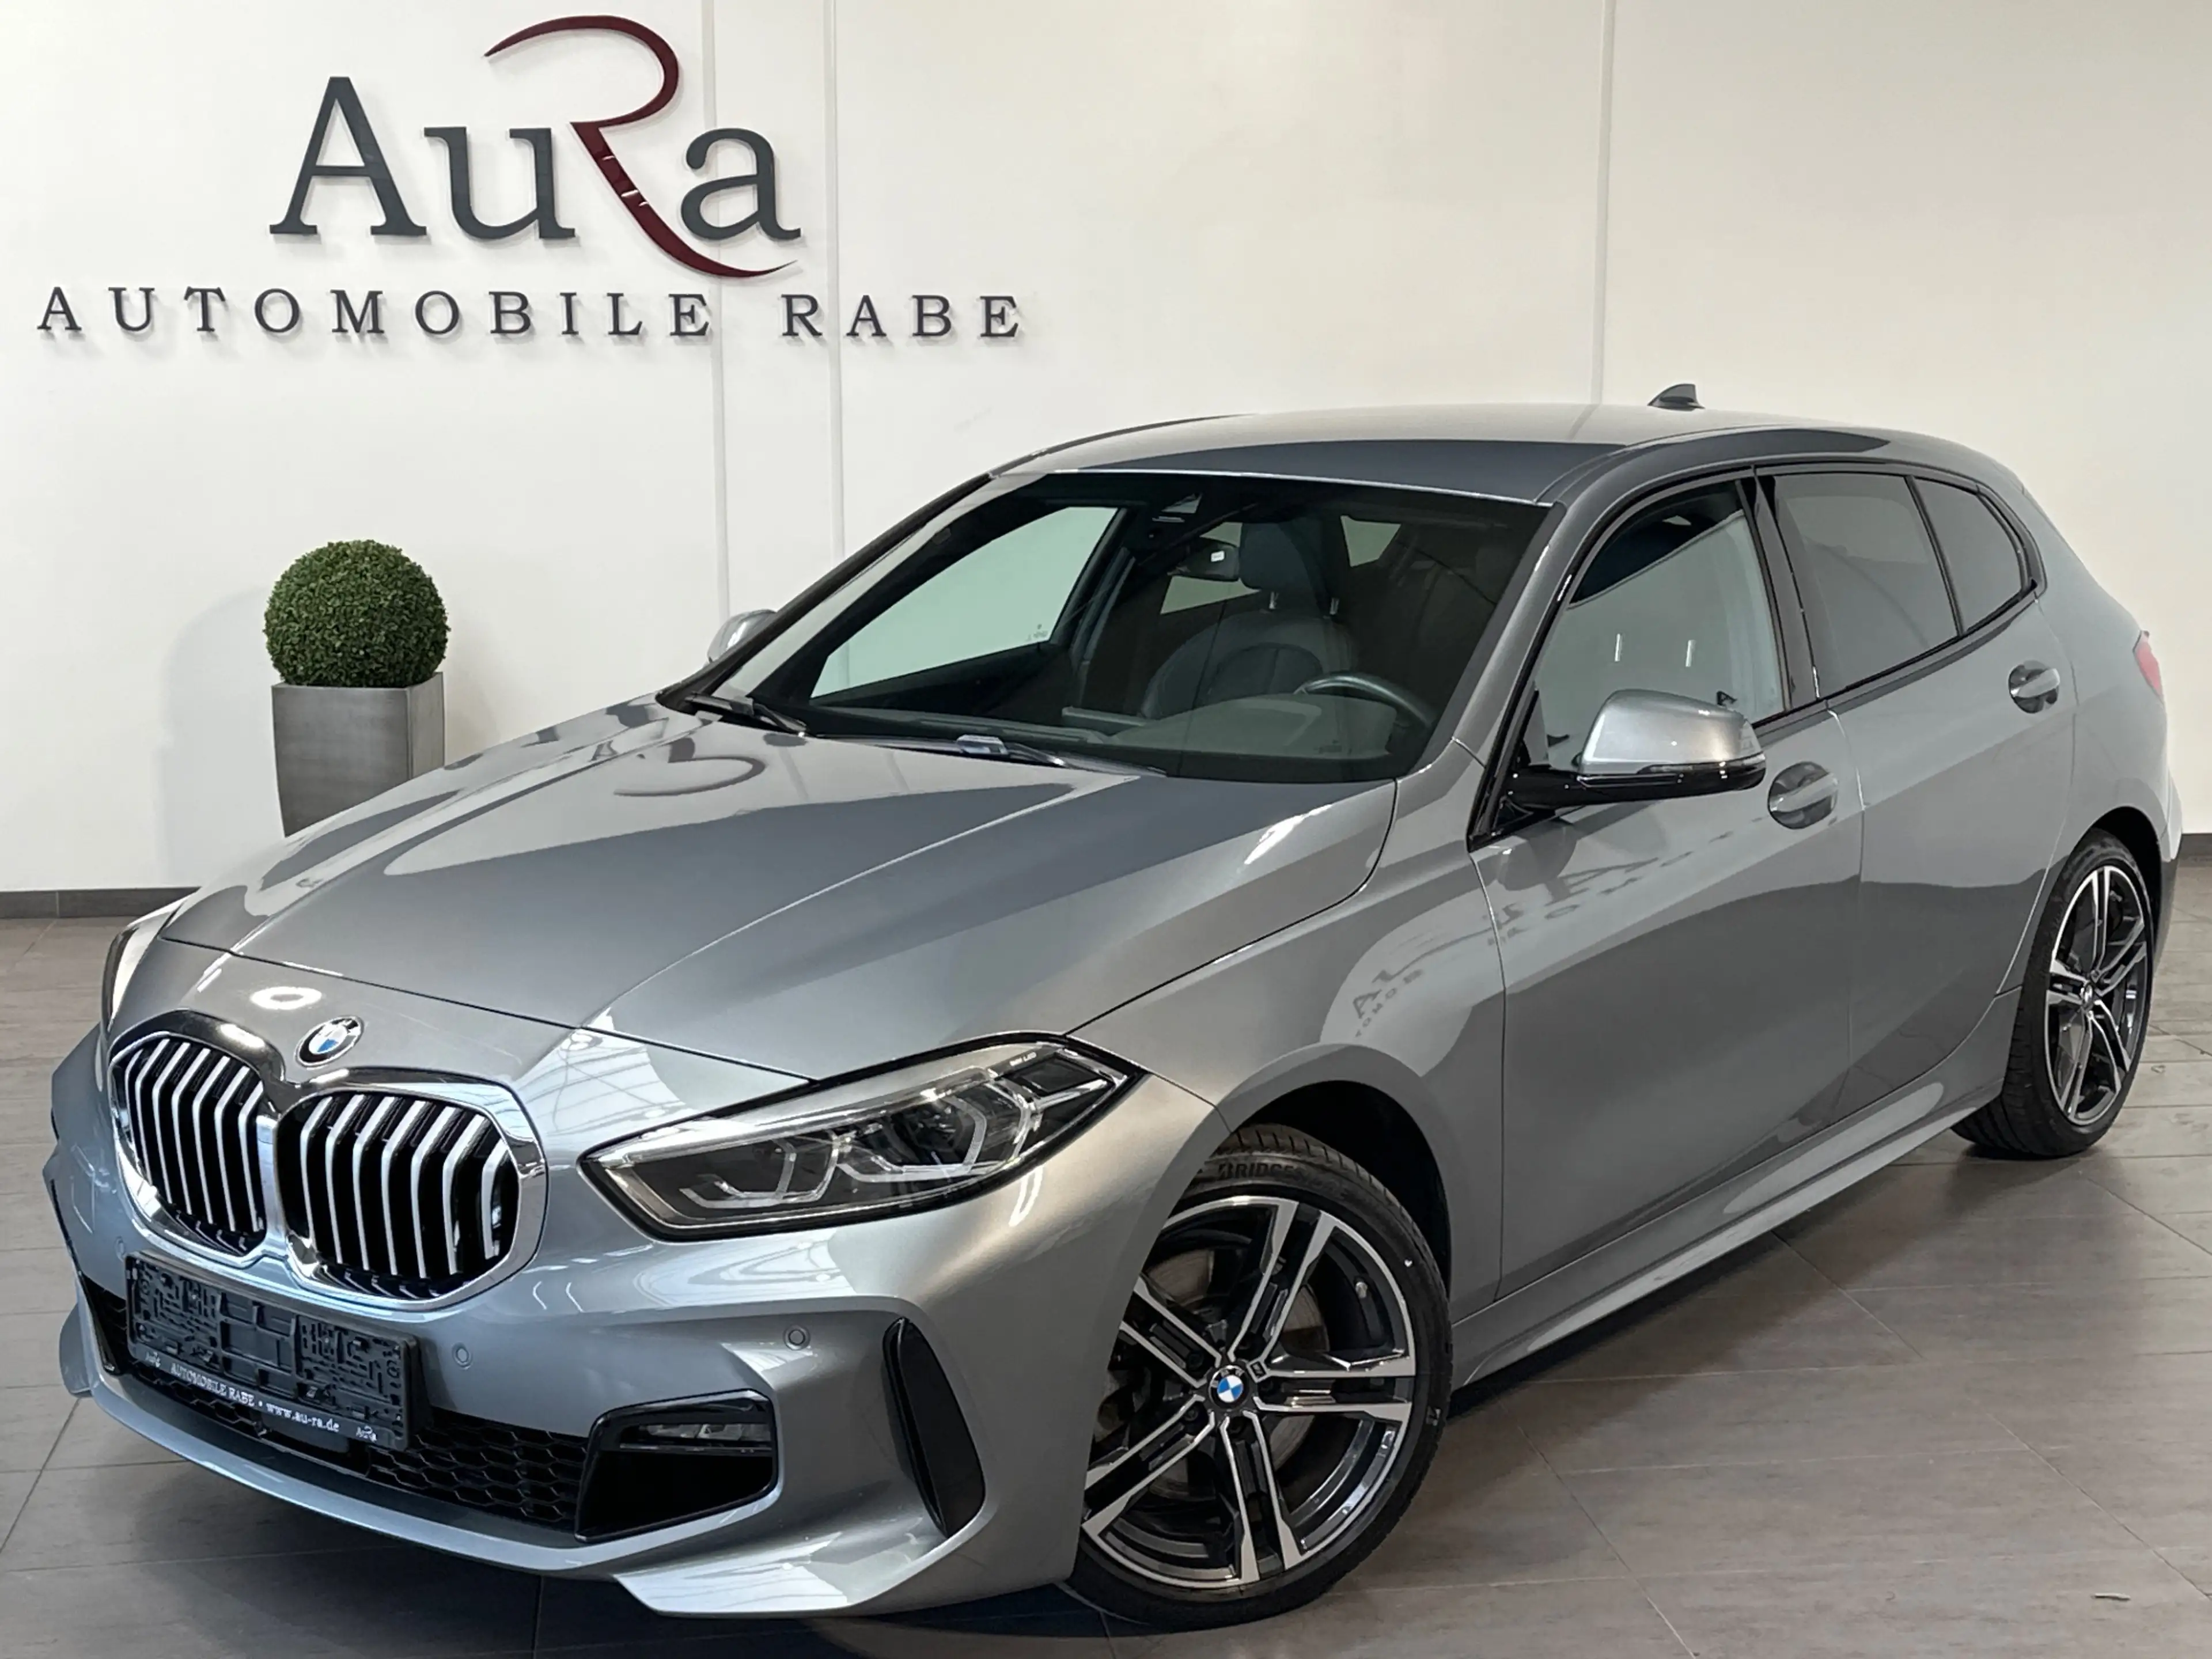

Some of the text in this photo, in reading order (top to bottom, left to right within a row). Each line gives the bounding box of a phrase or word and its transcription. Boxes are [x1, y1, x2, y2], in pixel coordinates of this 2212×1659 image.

[269, 16, 801, 278] AuRa
[37, 287, 1018, 338] AUTOMOBILE RABE
[227, 1386, 256, 1407] RABE
[266, 1402, 340, 1433] www.au-ra.de
